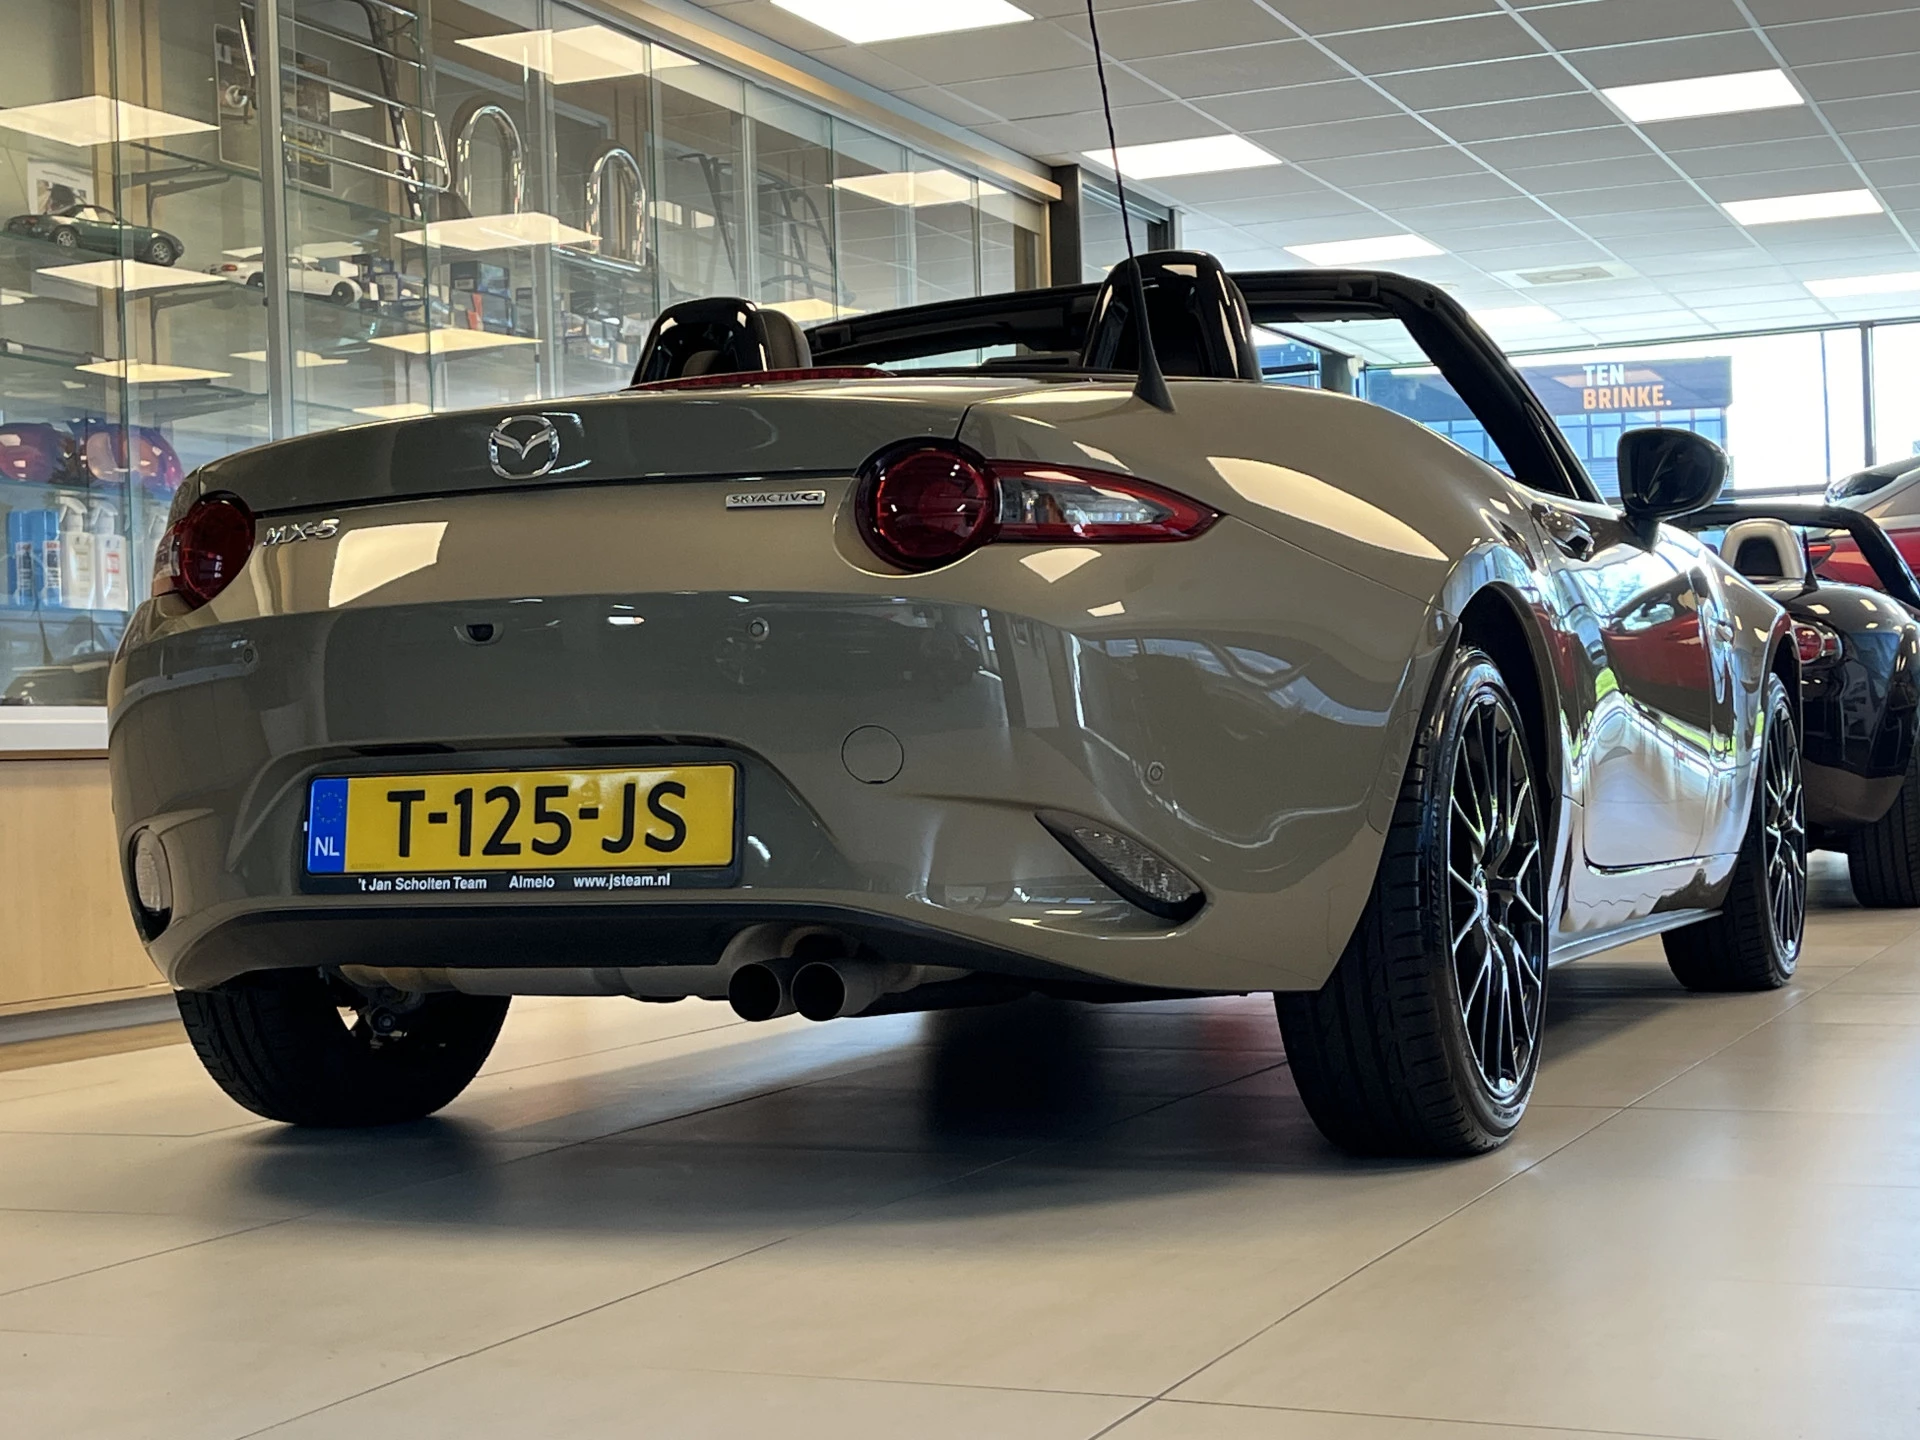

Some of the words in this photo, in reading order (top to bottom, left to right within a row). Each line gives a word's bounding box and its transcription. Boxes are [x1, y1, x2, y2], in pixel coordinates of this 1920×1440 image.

[1582, 364, 1625, 387] TEN
[1583, 385, 1672, 410] BRINKE.
[263, 518, 340, 546] MX-5
[387, 781, 687, 858] T-125-JS
[314, 836, 340, 857] NL
[369, 878, 392, 891] Jan
[395, 877, 450, 891] Scholten
[453, 876, 487, 890] Team
[509, 875, 555, 889] Almelo
[574, 872, 671, 890] www.jsteam.nl
